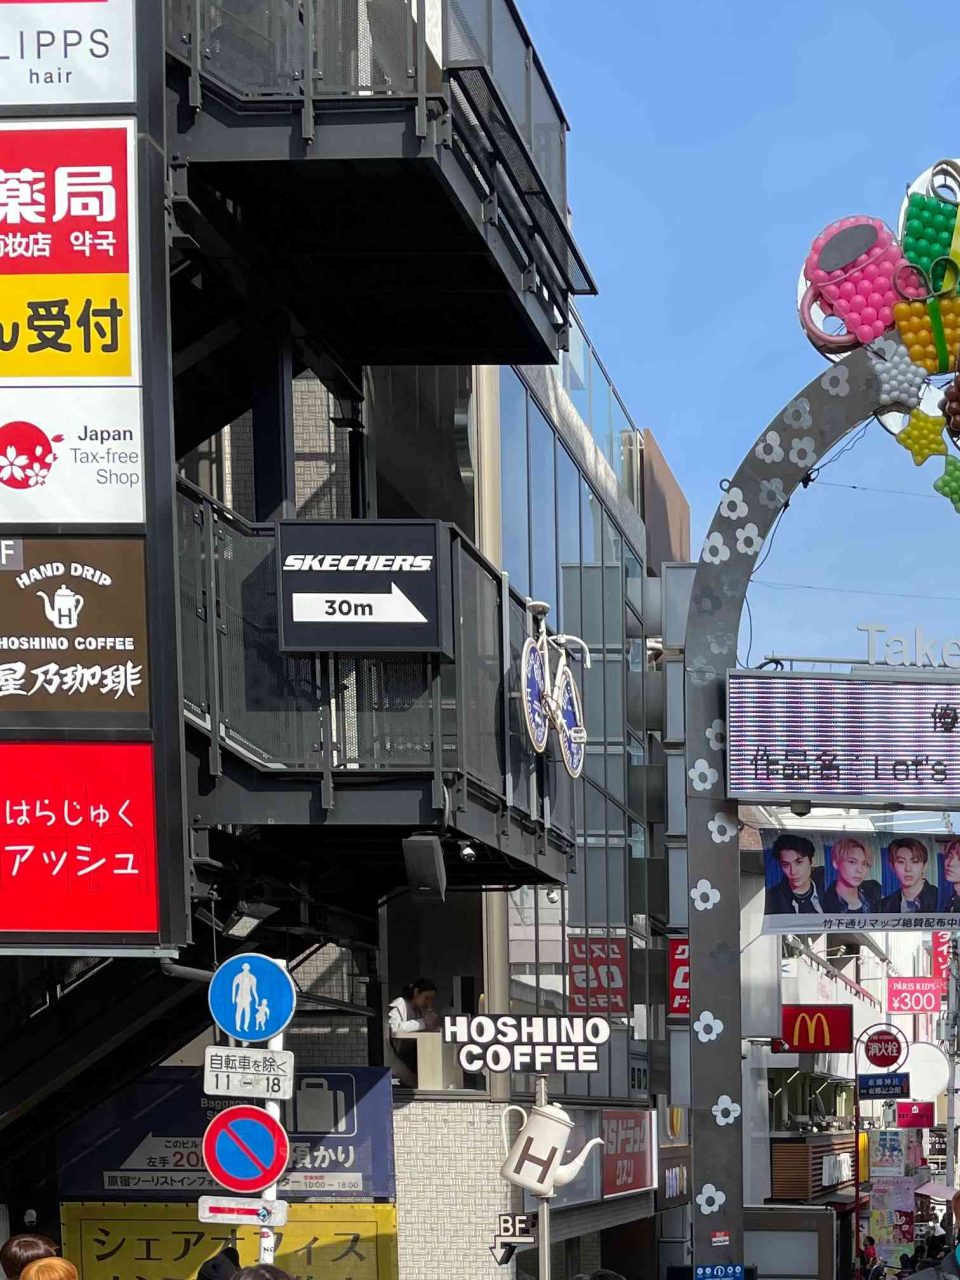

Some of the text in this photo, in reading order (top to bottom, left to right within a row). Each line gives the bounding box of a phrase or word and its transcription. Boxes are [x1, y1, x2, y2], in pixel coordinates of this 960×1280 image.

[28, 68, 73, 85] hair
[0, 166, 117, 223] 薬局
[70, 230, 117, 257] 약국
[78, 425, 134, 445] Japan
[70, 447, 139, 464] Tax-free
[96, 468, 140, 488] Shop
[282, 554, 434, 572] SKECHERS
[15, 562, 113, 589] HAND DRIP
[324, 599, 374, 616] 30m
[0, 637, 135, 650] HOSHINO COFFEE
[6, 799, 137, 828] はらじゅく
[4, 845, 139, 877] アッシュ
[893, 982, 914, 990] PARIS
[892, 992, 935, 1010] ¥300
[444, 1016, 610, 1043] HOSHINO
[459, 1044, 598, 1072] COFFEE
[868, 1041, 898, 1056] 消火栓
[210, 1053, 287, 1073] 自転車を除く
[215, 1073, 230, 1090] 11
[265, 1076, 281, 1093] 18
[500, 1216, 526, 1236] BF
